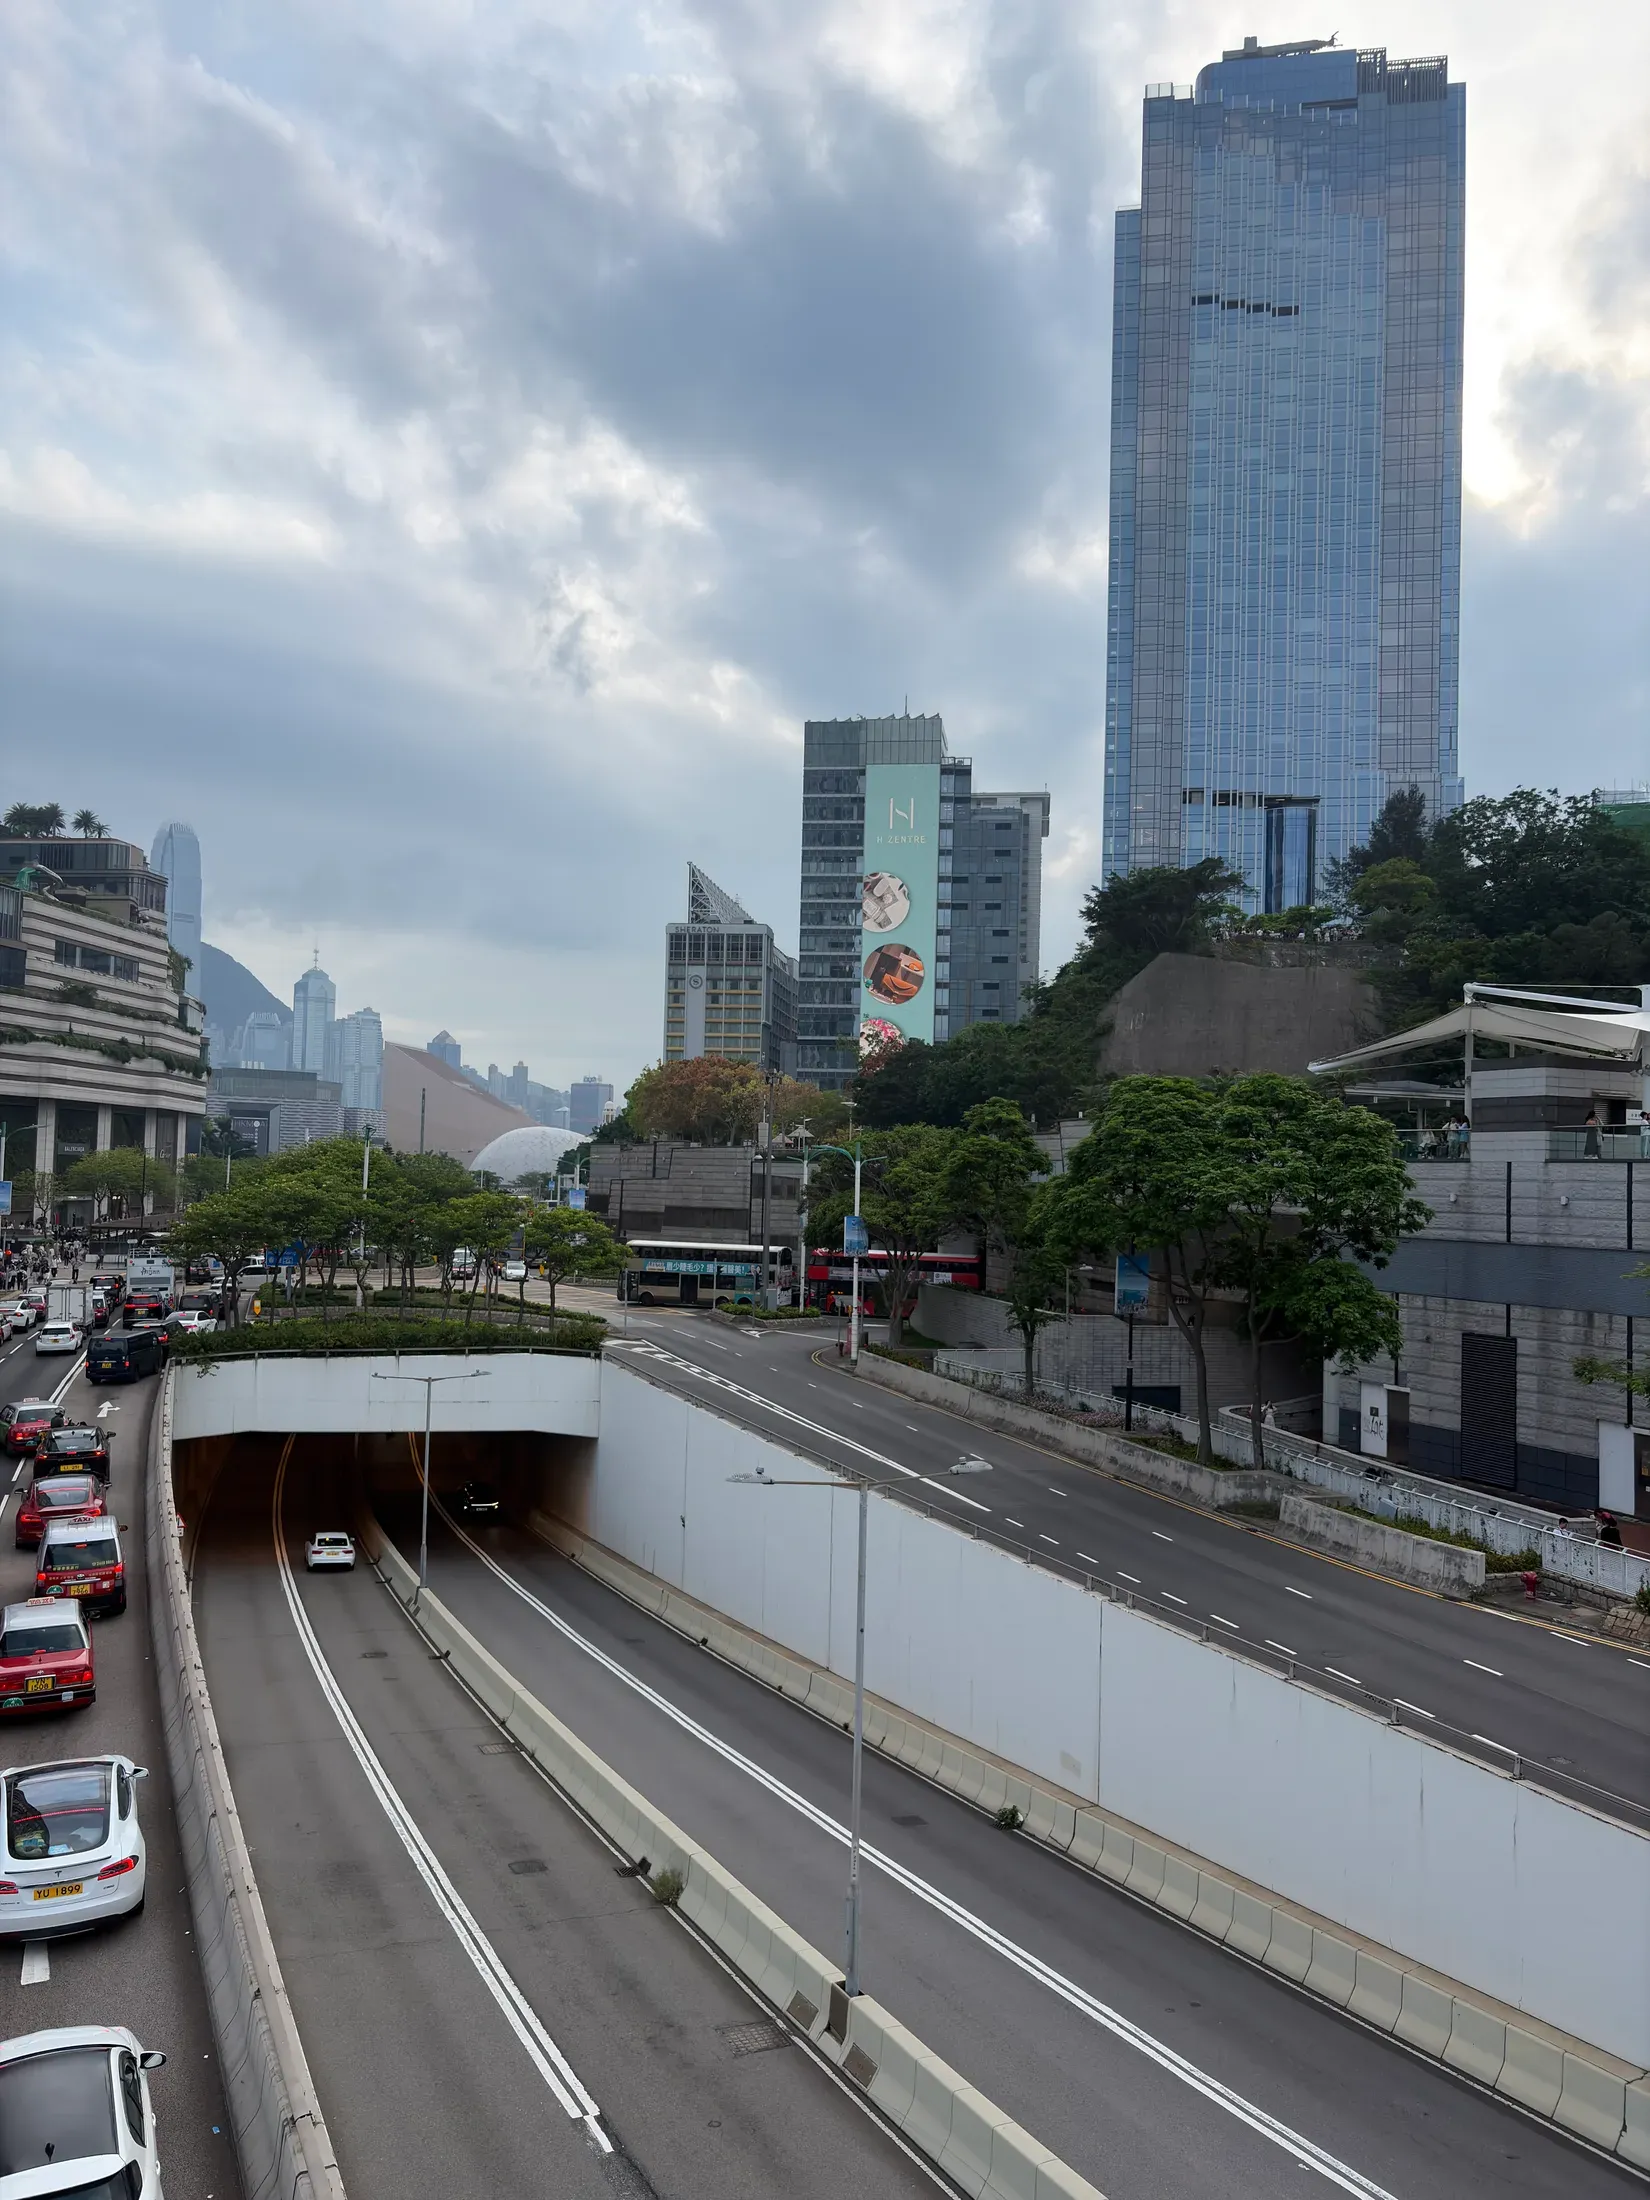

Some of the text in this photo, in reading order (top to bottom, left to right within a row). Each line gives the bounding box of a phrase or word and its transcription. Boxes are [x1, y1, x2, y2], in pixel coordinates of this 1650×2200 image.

[888, 835, 926, 844] ZENTRE
[36, 1884, 81, 1899] YU 1899
